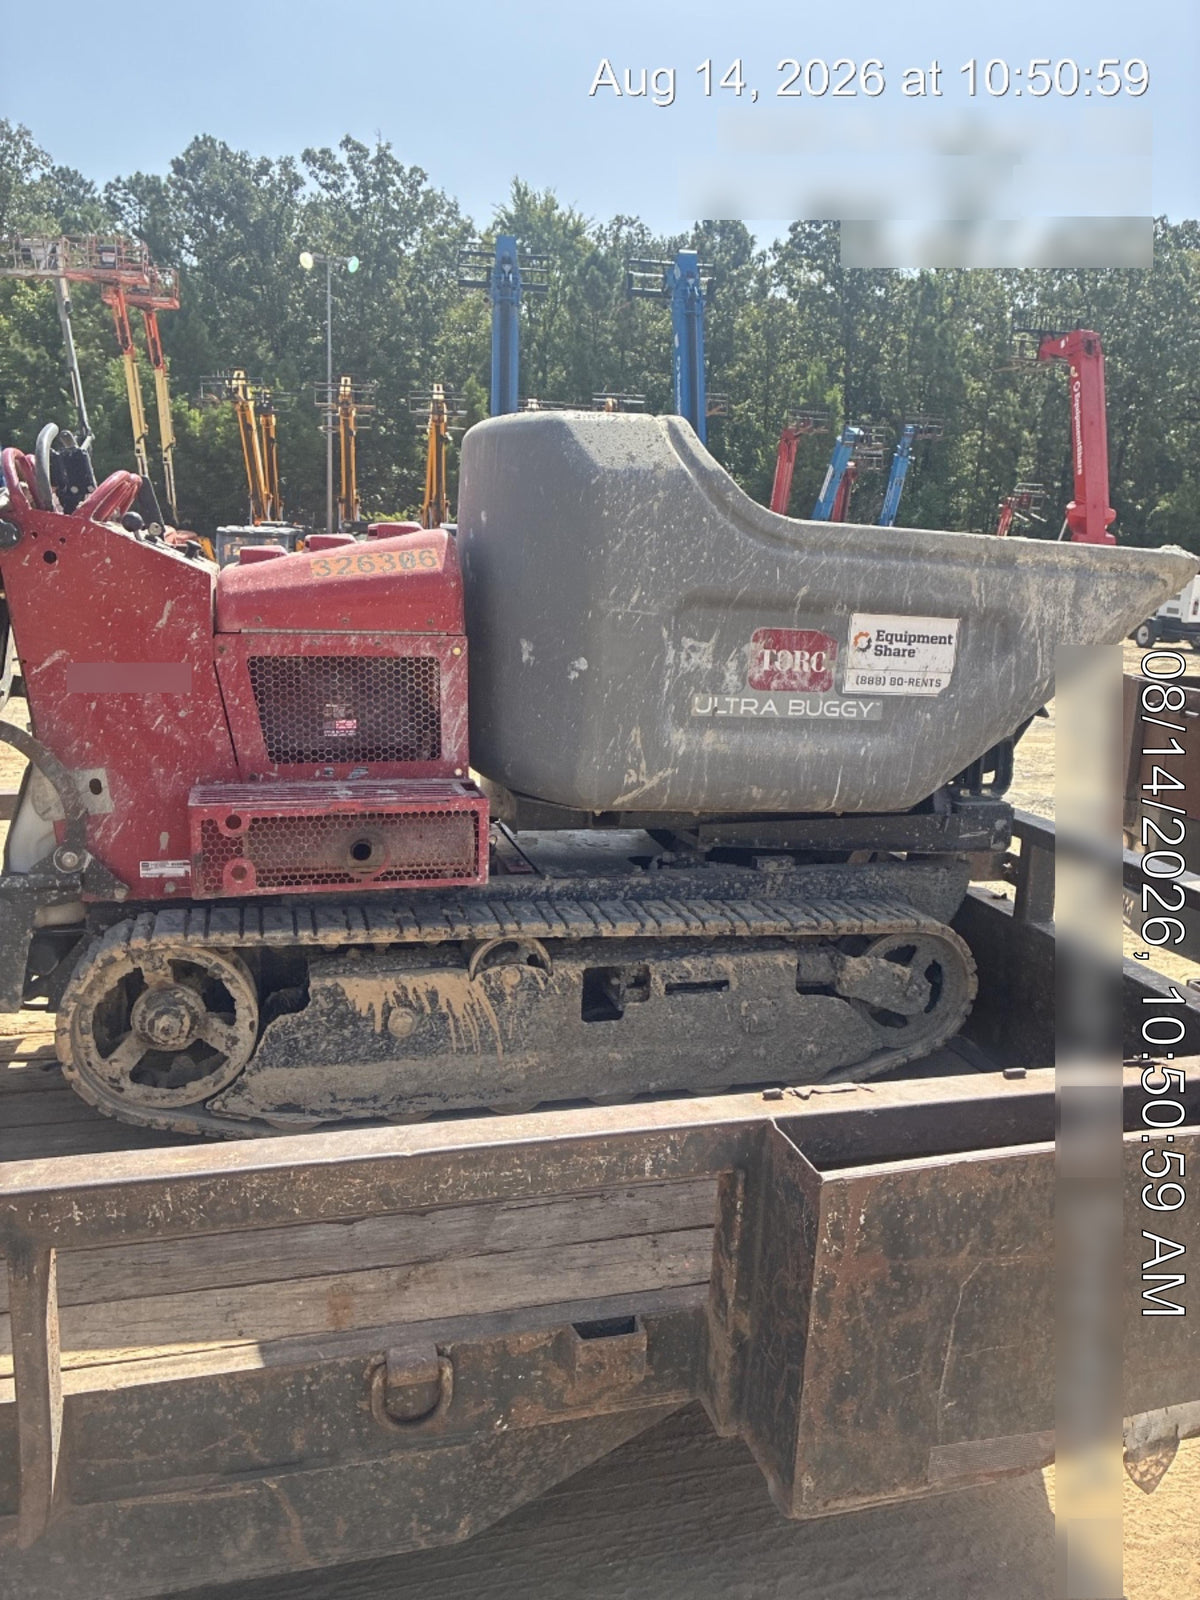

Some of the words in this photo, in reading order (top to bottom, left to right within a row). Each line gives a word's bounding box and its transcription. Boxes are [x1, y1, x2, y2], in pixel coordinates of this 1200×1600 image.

[312, 549, 438, 577] 326306
[875, 630, 954, 646] Equipment
[873, 644, 916, 658] Share
[855, 675, 887, 687] (888)
[694, 697, 779, 716] ULTRA
[787, 700, 874, 718] BUGGY
